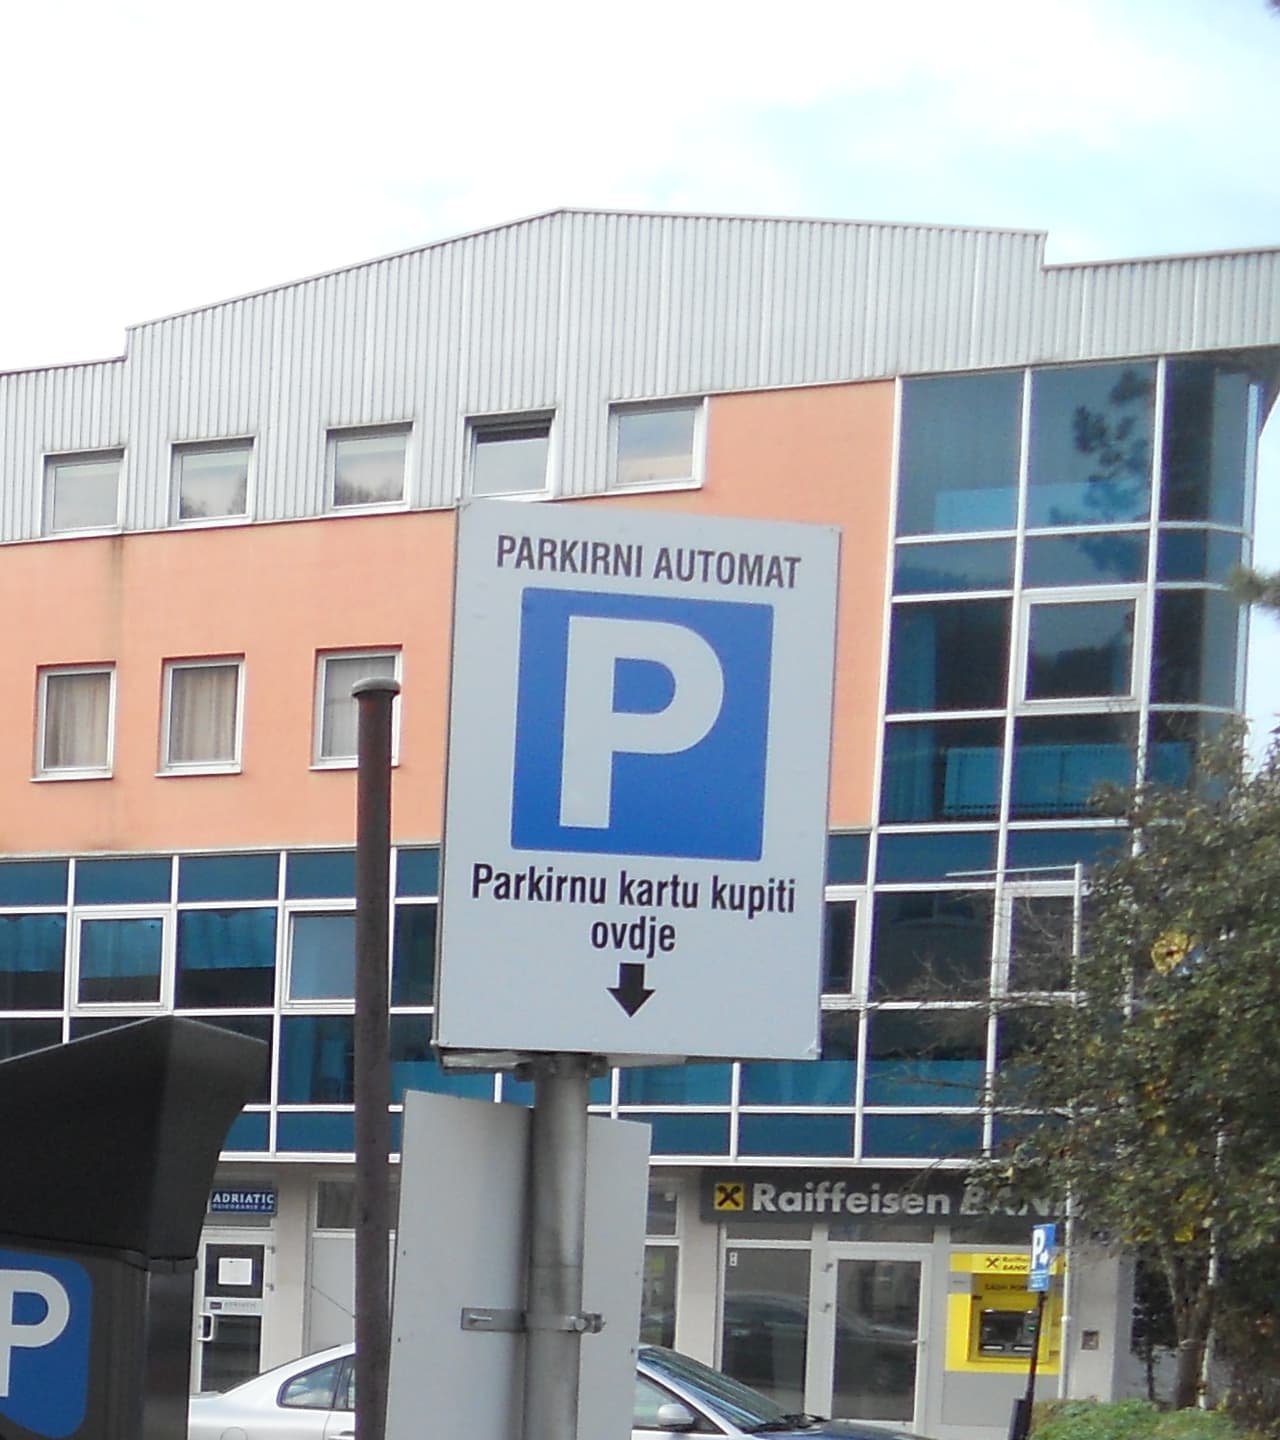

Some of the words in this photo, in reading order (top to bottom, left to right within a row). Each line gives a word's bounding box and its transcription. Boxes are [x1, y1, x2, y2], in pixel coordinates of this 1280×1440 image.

[496, 534, 643, 578] PARKIRNI
[652, 546, 802, 589] AUTOMAT
[559, 615, 725, 829] P
[471, 862, 607, 905] Parkirnu
[619, 869, 700, 909] kartu
[711, 874, 796, 920] kupiti
[591, 915, 676, 959] ovdje
[212, 1193, 275, 1204] ADRIATIC
[752, 1181, 951, 1215] Raiffeisen
